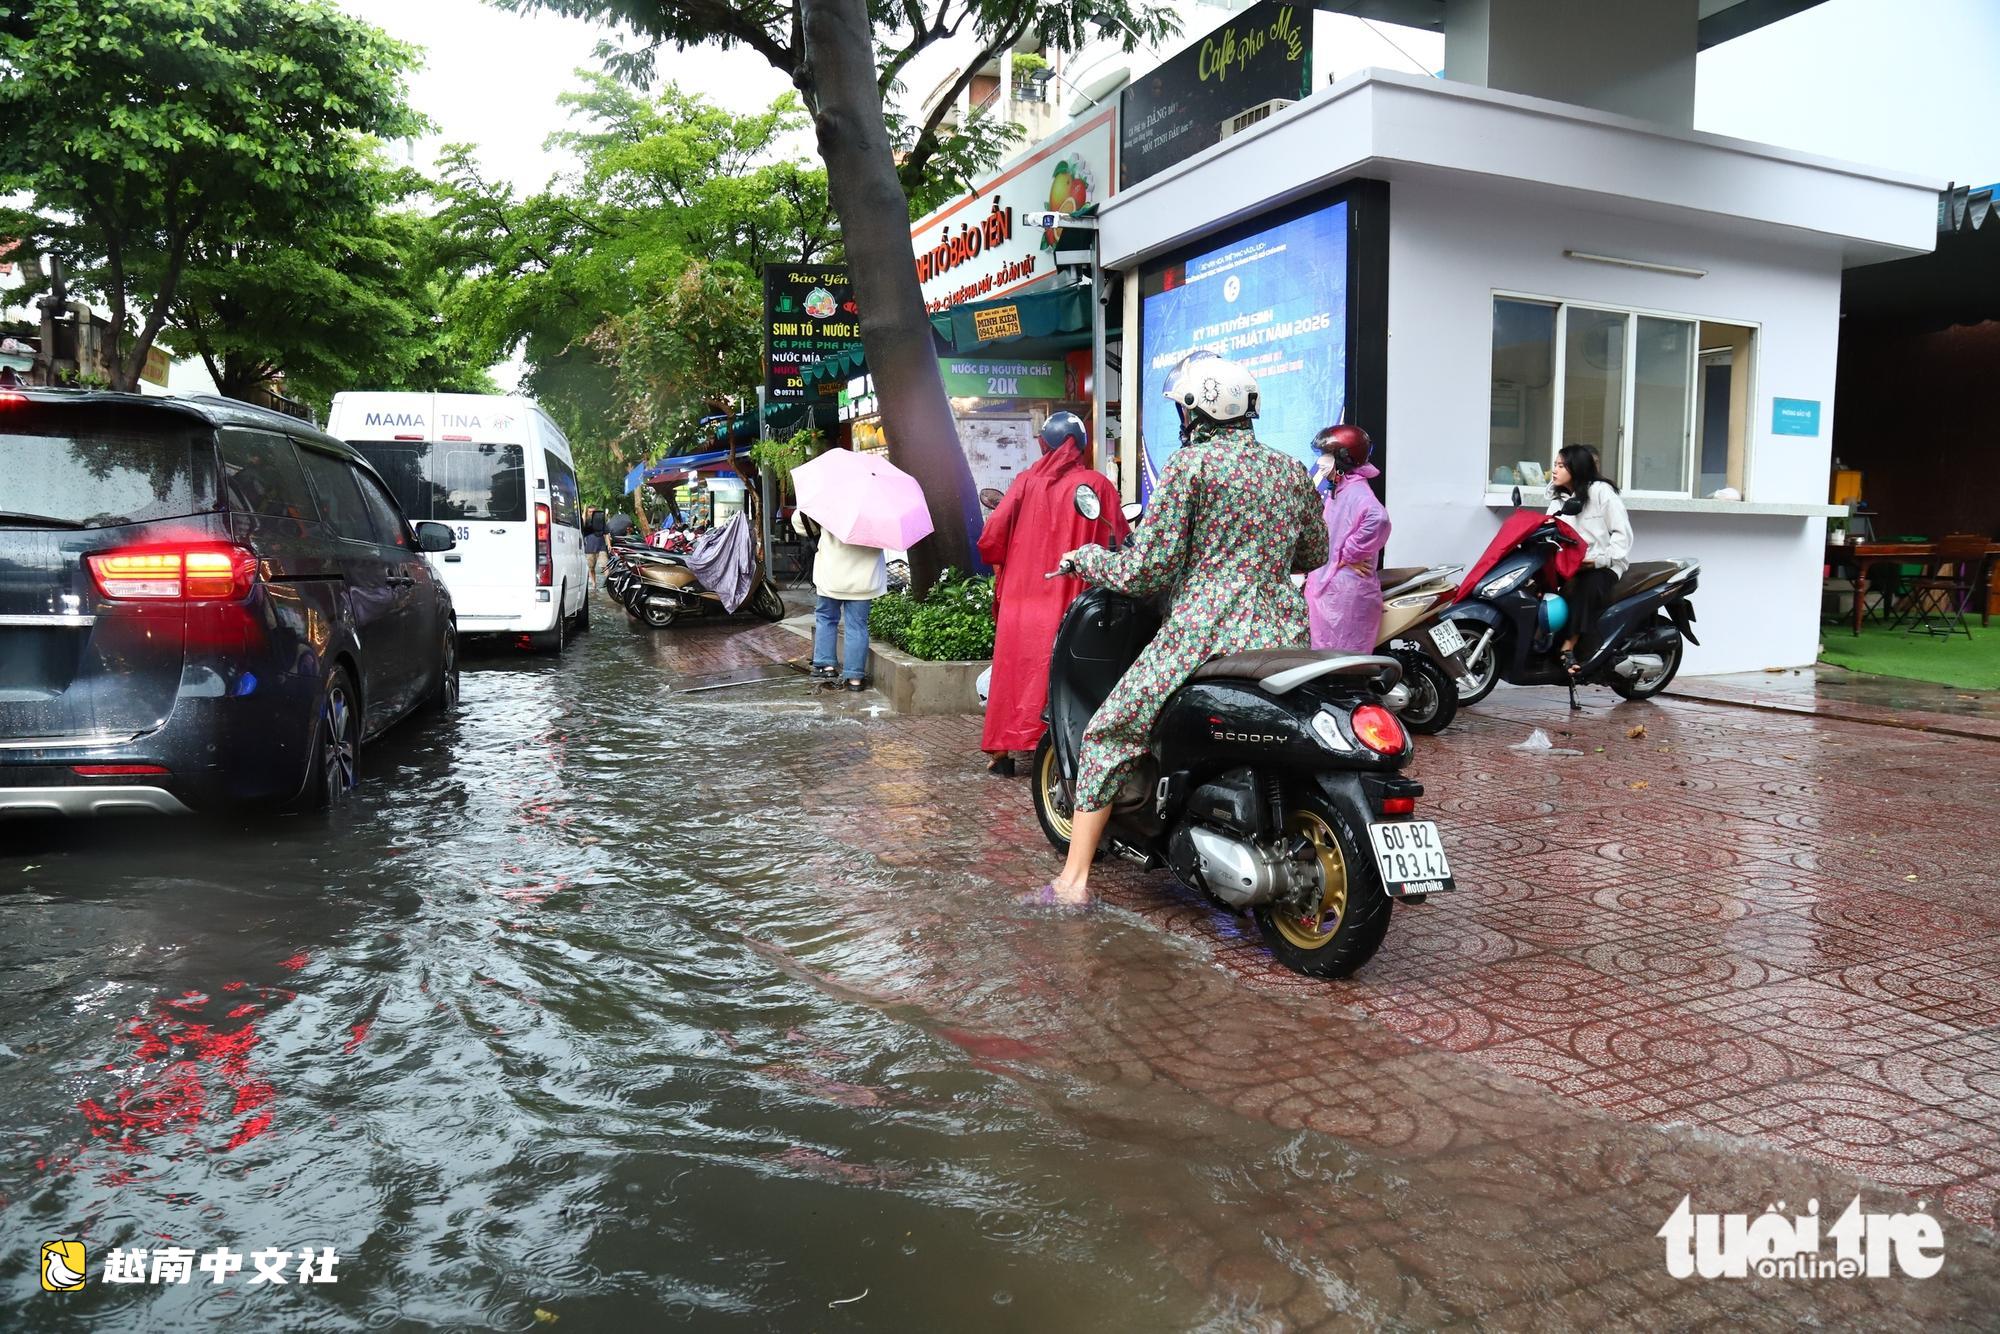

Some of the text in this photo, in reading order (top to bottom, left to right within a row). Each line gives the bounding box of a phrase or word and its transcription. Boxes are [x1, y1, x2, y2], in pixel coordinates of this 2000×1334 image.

[1199, 28, 1236, 82] Café
[1269, 6, 1303, 61] Máy
[916, 195, 1012, 284] NH TỐ BẢO YẾN
[788, 272, 849, 286] Bảo Yến
[773, 323, 797, 336] SINH
[801, 320, 813, 336] TỐ
[823, 322, 850, 337] NƯỚC
[853, 322, 860, 337] É
[977, 316, 998, 328] MINH
[1294, 312, 1330, 335] 2026
[816, 341, 839, 350] PHA
[772, 351, 821, 363] NƯỚC MÍA
[951, 362, 977, 374] NƯỚC
[991, 363, 1028, 375] NGUYÊN
[1029, 361, 1053, 376] CHẤT
[987, 378, 1018, 395] 20K
[365, 413, 482, 428] MAMA TINA
[1214, 732, 1288, 743] SCOOPY
[1382, 852, 1448, 880] 783.42
[1402, 880, 1444, 895] Motorbike
